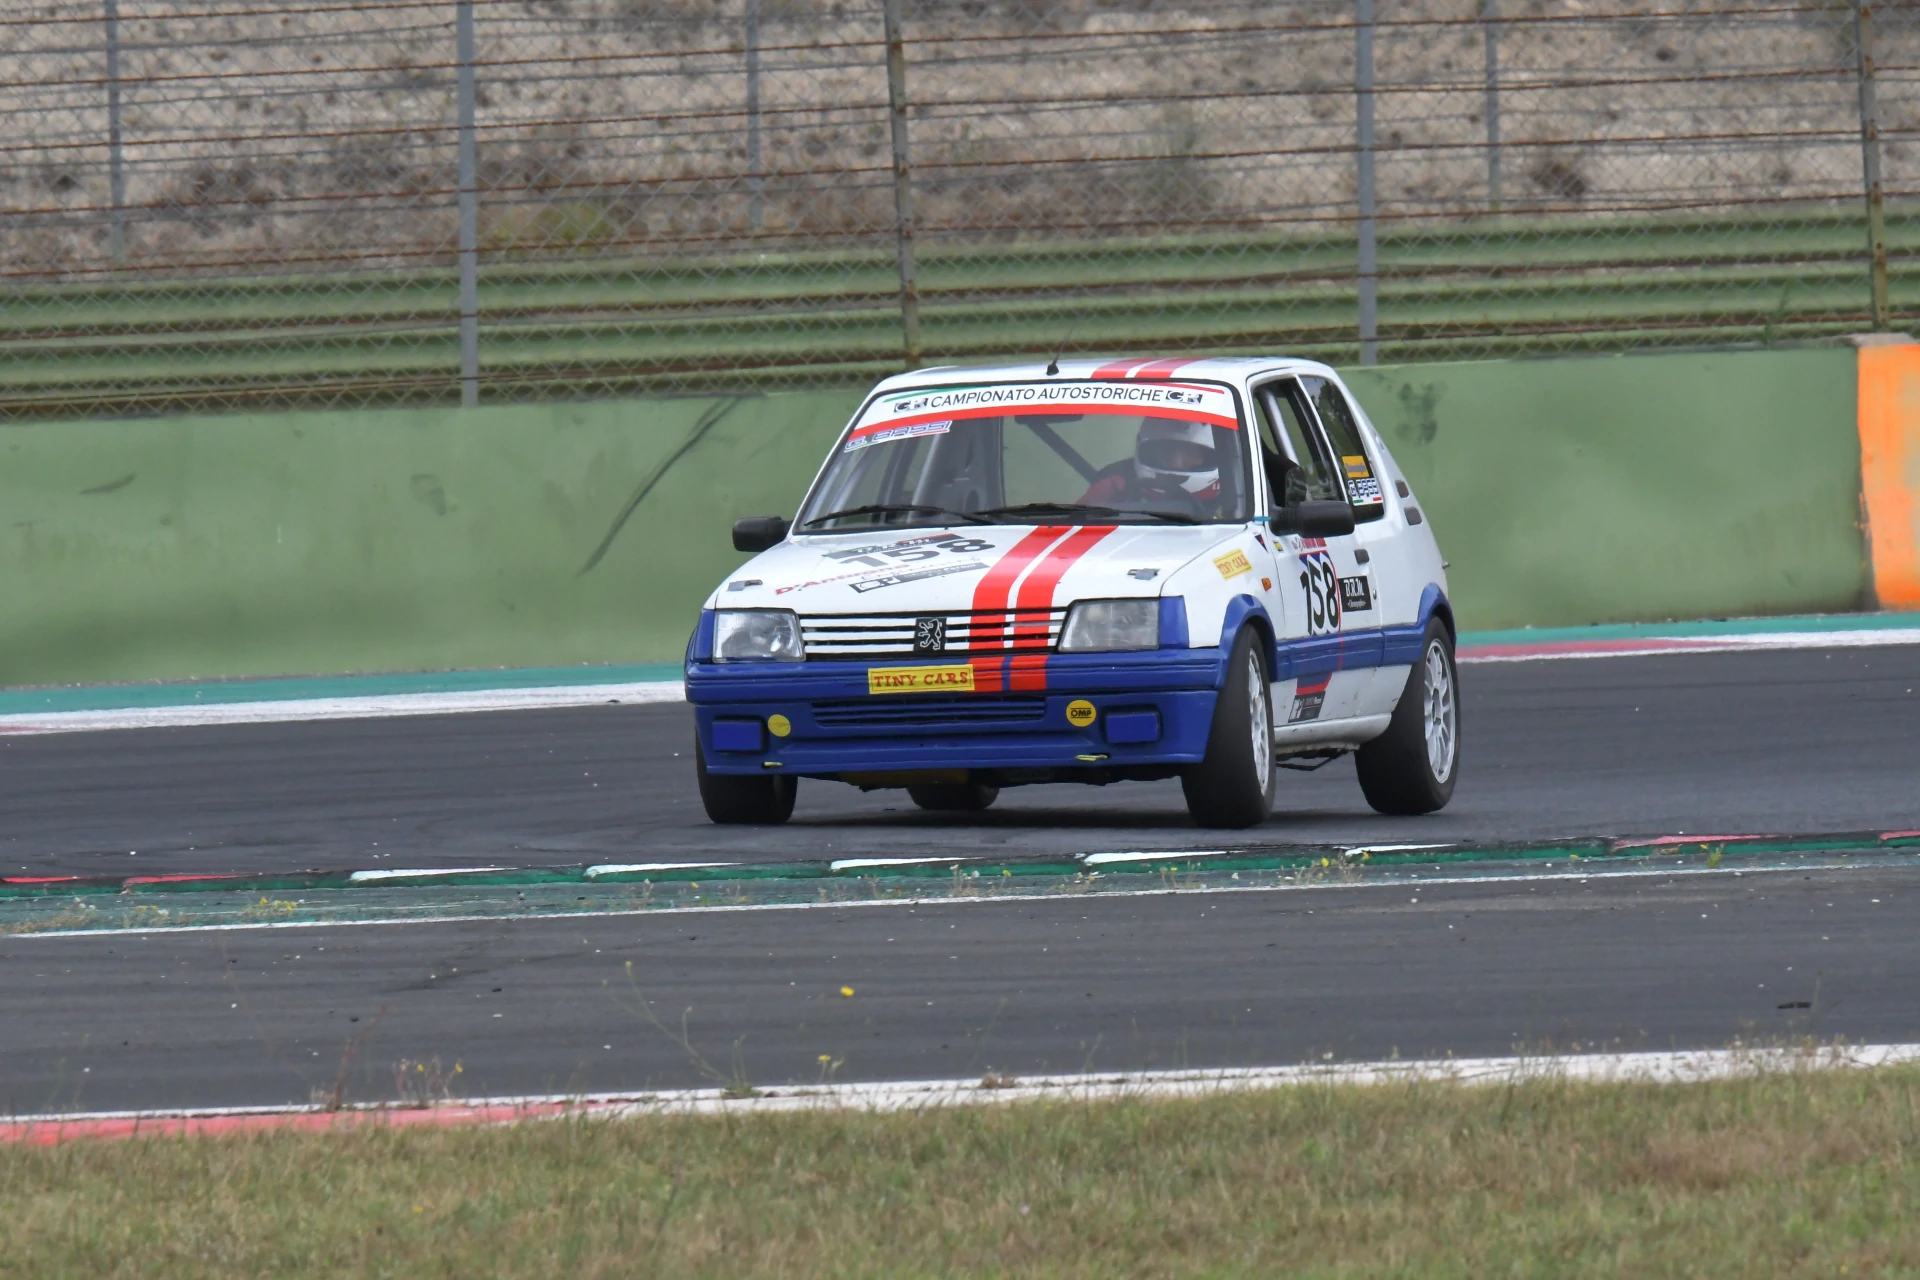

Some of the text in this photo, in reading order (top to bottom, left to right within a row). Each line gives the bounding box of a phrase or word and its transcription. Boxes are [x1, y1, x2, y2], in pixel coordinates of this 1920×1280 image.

[931, 389, 1035, 408] CAMPIONATO
[1038, 386, 1163, 402] AUTOSTORICHE
[872, 420, 951, 441] BASSI
[838, 538, 996, 568] 158
[1300, 561, 1339, 635] 158
[873, 671, 969, 688] TINY CARS
[1070, 708, 1093, 719] OMP
